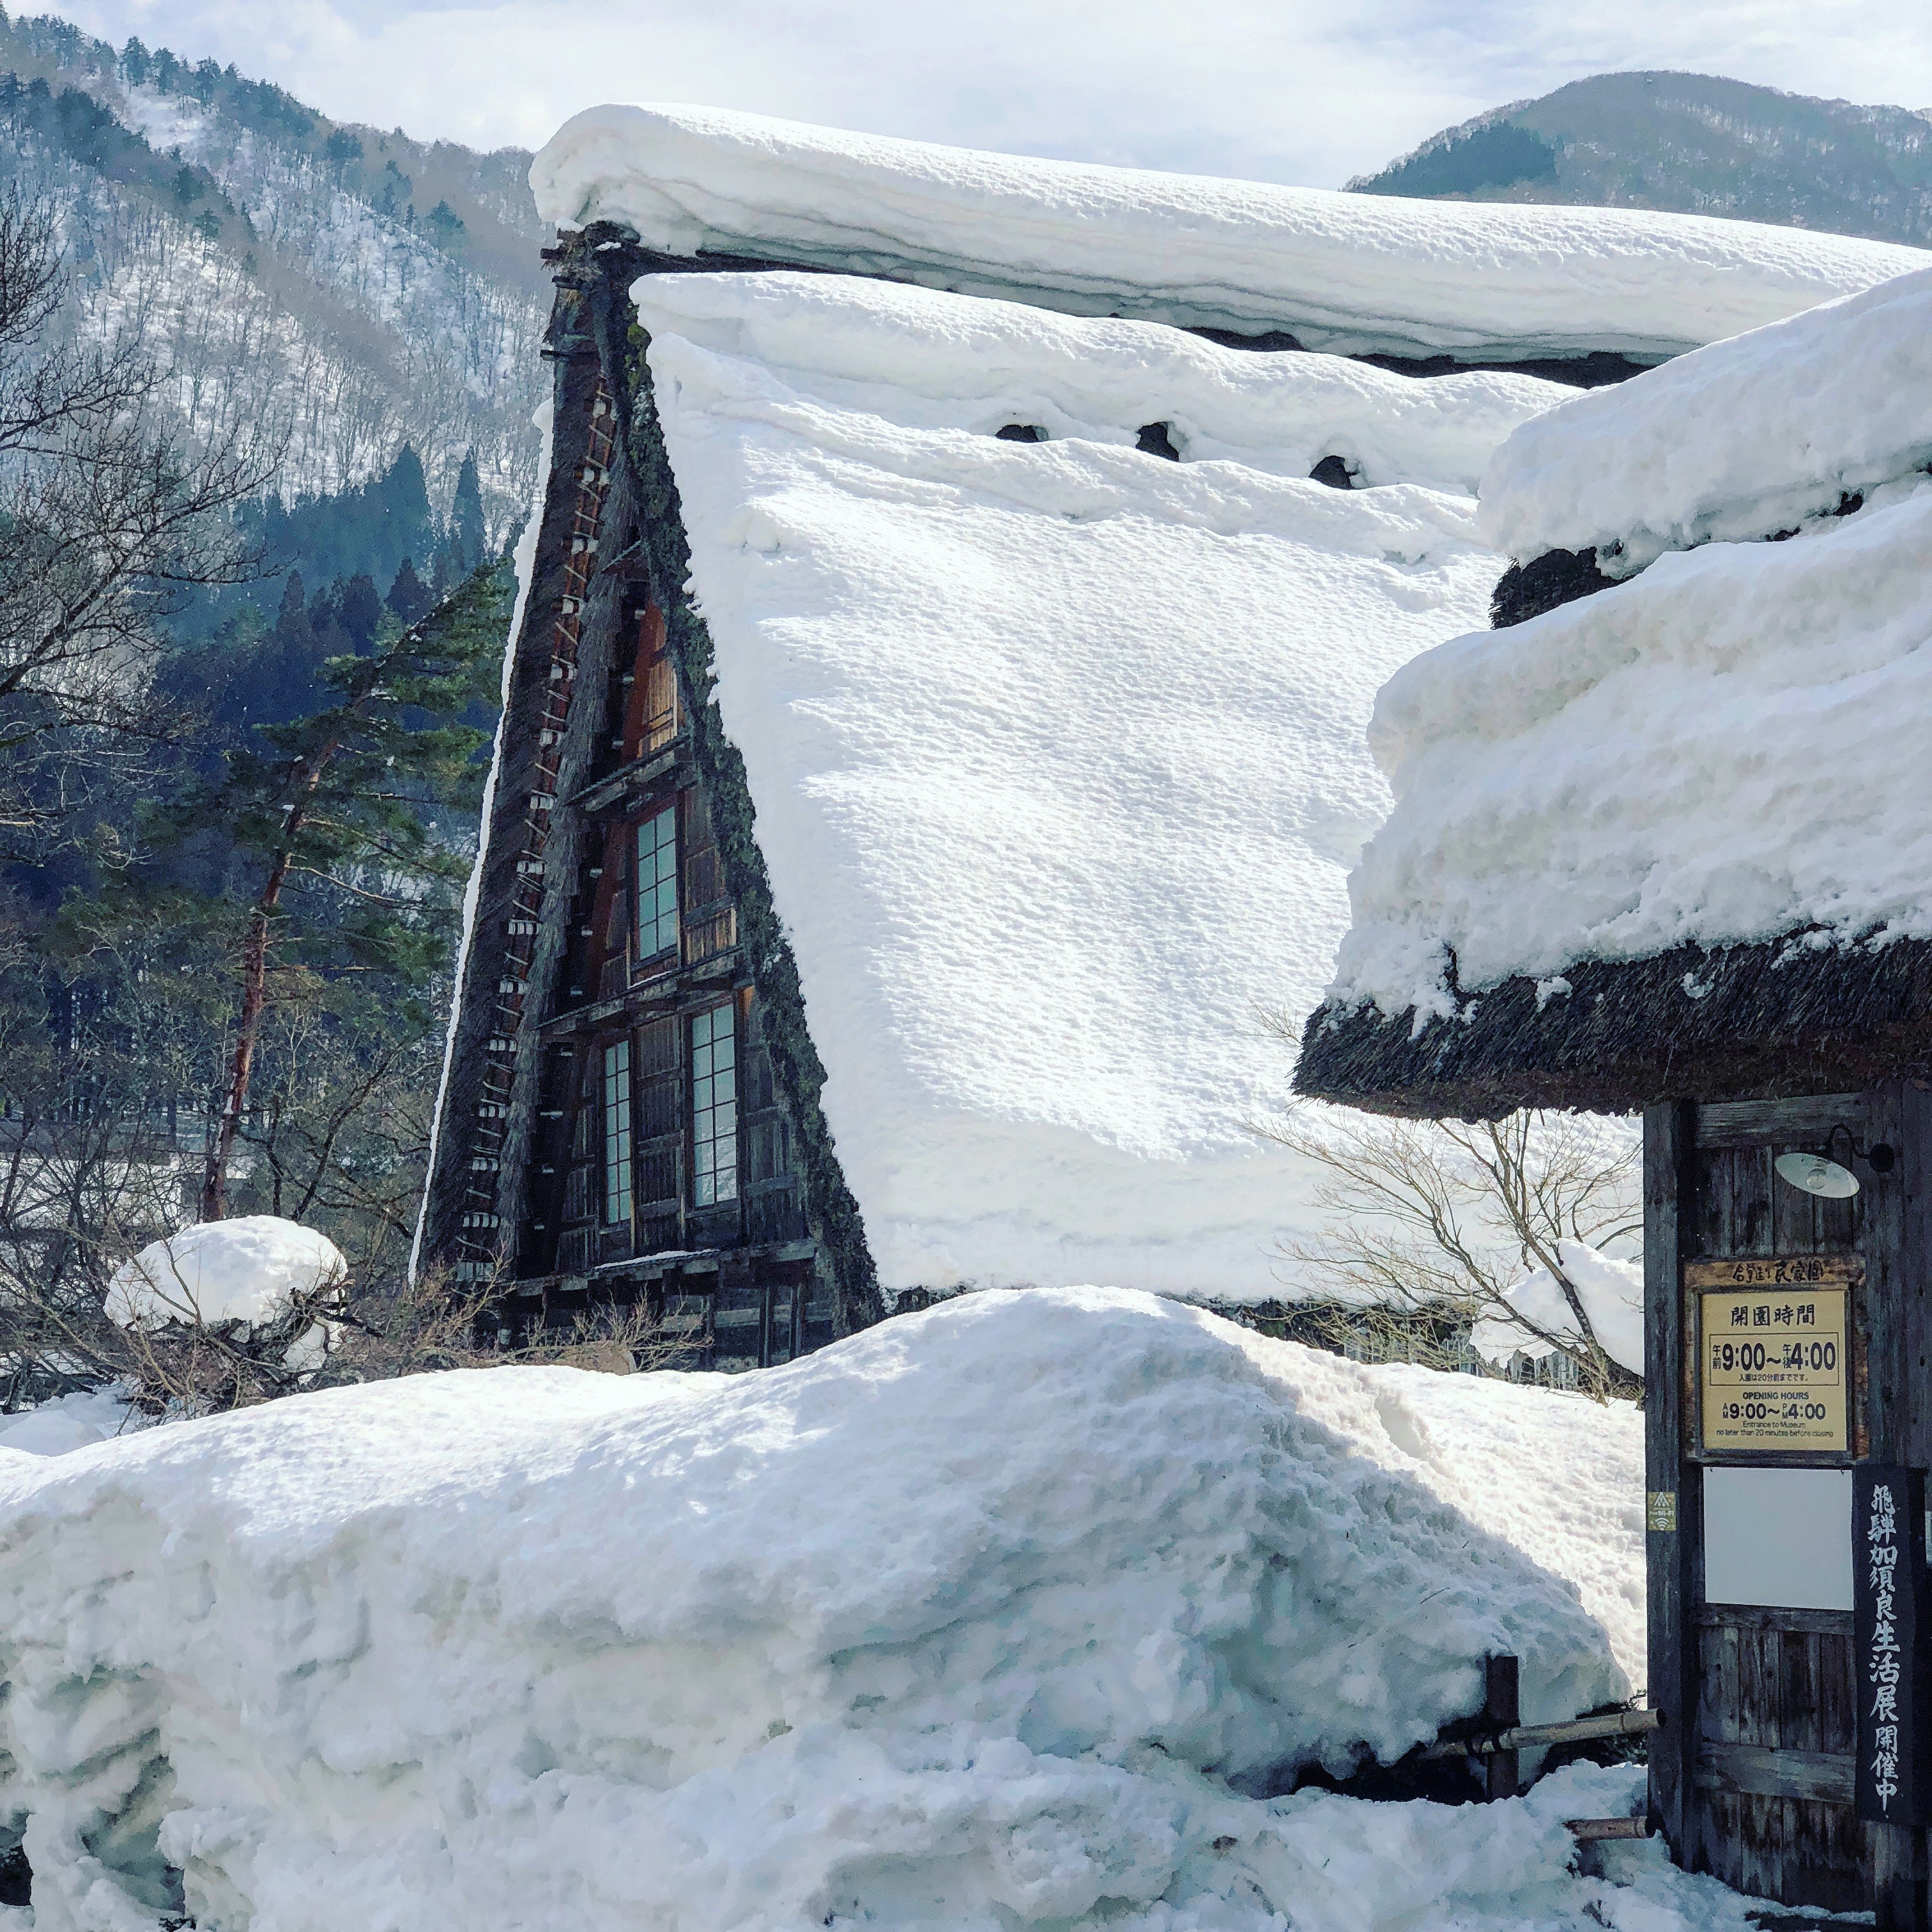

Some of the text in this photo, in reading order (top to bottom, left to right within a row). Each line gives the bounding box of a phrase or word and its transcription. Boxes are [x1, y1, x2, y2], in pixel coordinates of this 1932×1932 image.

[1731, 1304, 1815, 1326] 開園時間
[1742, 1392, 1809, 1400] OPENING HOURS
[1812, 1429, 1834, 1438] closing
